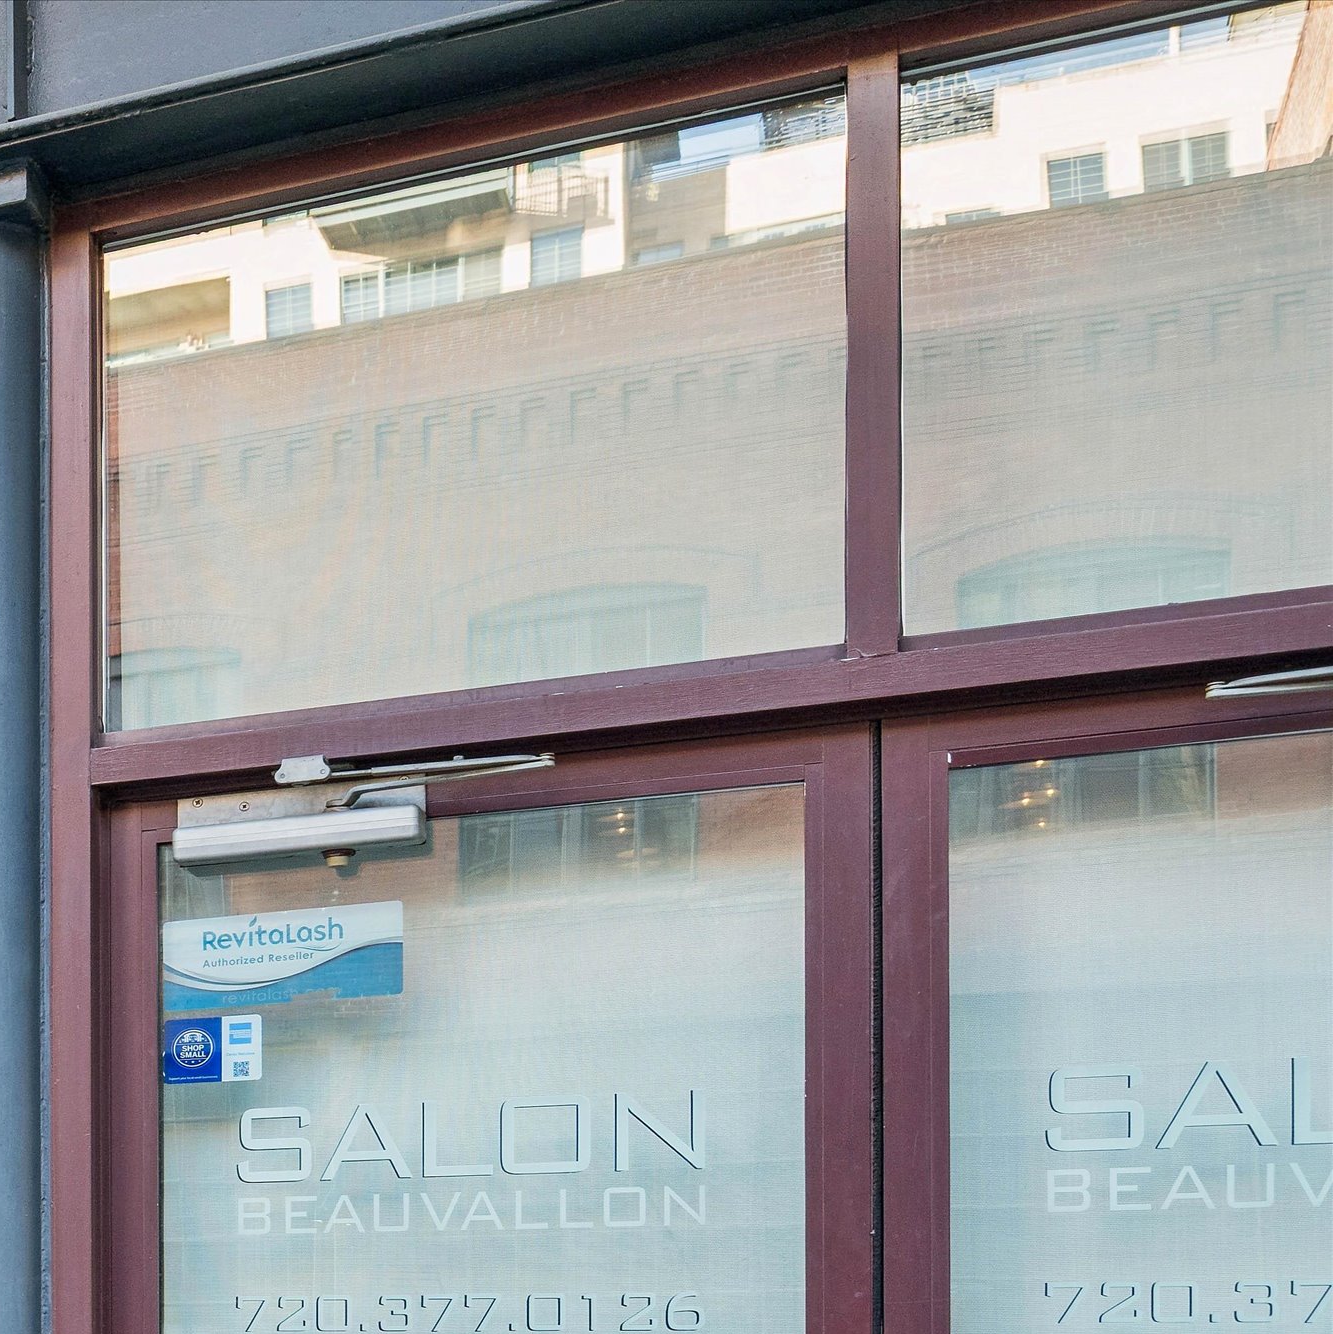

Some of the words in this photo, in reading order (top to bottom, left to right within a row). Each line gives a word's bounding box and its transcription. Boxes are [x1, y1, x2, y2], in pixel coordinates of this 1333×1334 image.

[202, 916, 344, 951] RevitaLash
[202, 956, 264, 969] Authorized
[269, 951, 315, 963] Reseller
[222, 986, 342, 1005] revitalashcom
[180, 1051, 207, 1059] SMALL
[181, 1044, 205, 1052] SHOP
[236, 1089, 706, 1184] SALON
[238, 1184, 707, 1236] BEAUVALLON
[233, 1294, 702, 1334] 720.377.0126
